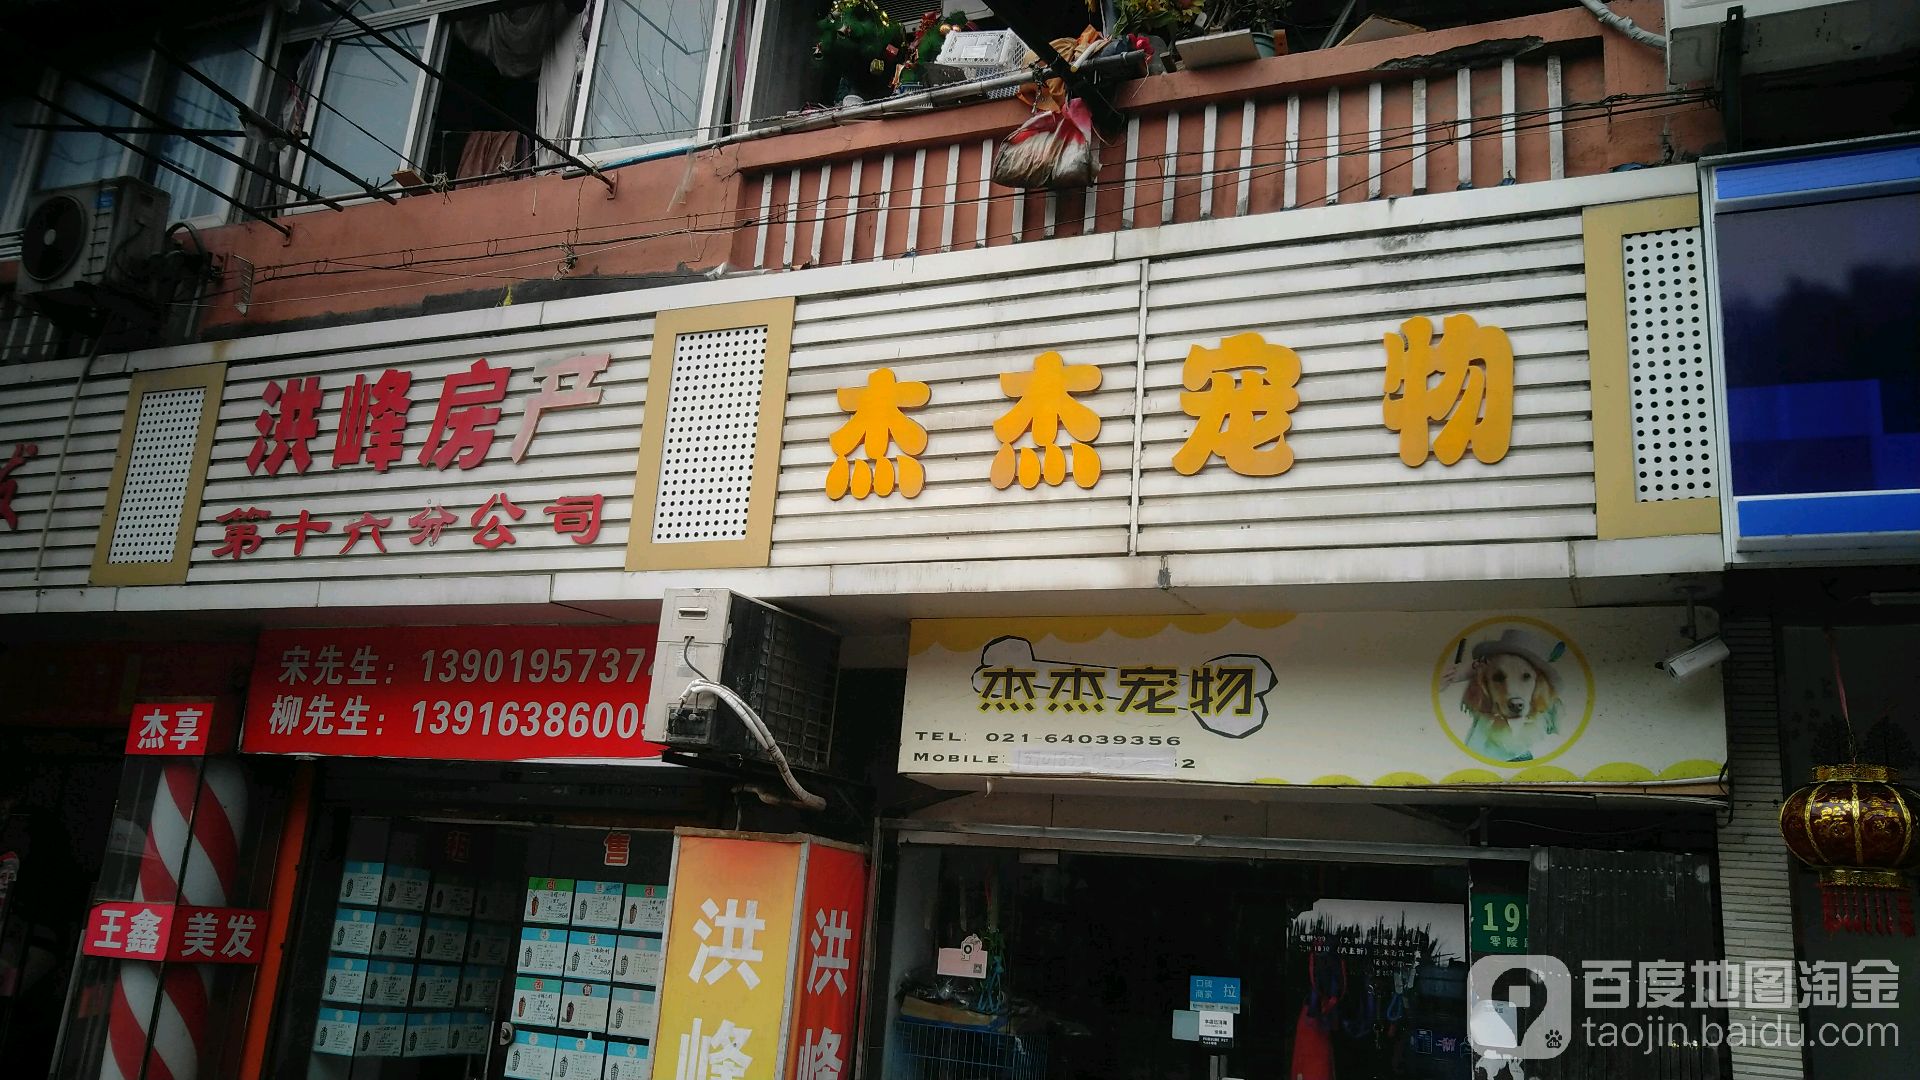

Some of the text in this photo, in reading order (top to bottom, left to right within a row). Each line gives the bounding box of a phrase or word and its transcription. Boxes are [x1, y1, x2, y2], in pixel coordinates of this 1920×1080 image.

[246, 352, 611, 476] 洪峰房产
[825, 313, 1514, 500] 杰杰宠物
[211, 492, 604, 561] 第十六分公司
[421, 649, 655, 684] 1390195737
[977, 664, 1256, 716] 杰杰宠物
[137, 707, 204, 750] 杰享
[411, 701, 649, 740] 1391638600
[985, 732, 1182, 746] 021-64039356
[604, 832, 631, 867] 售
[94, 909, 163, 955] 王鑫
[181, 911, 257, 959] 美发
[1483, 903, 1528, 932] 19
